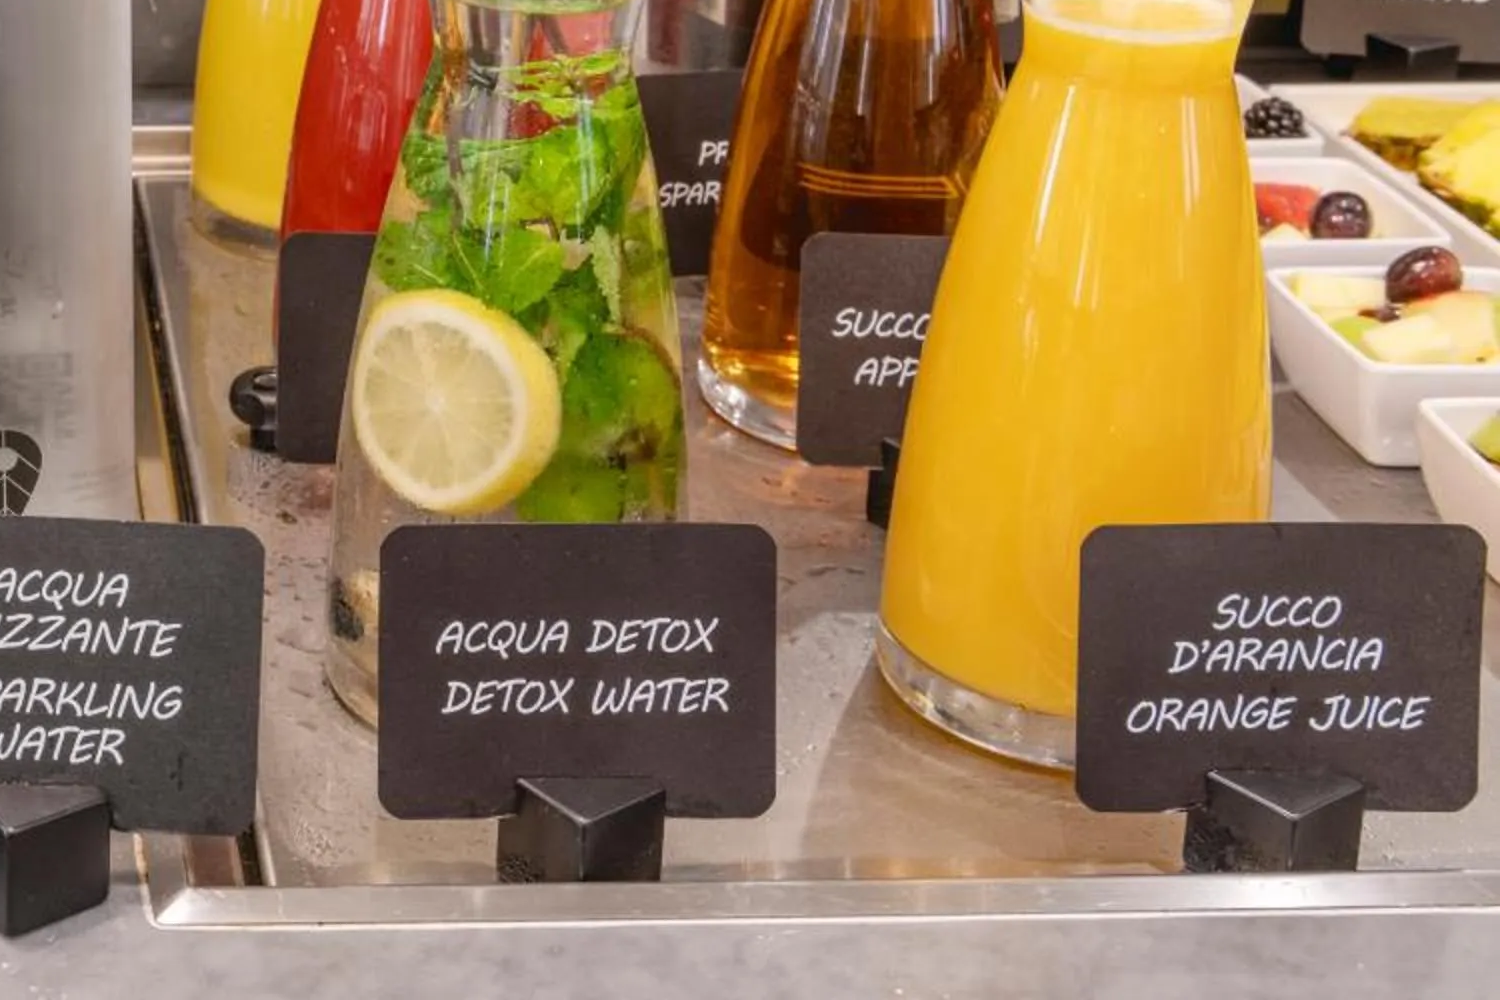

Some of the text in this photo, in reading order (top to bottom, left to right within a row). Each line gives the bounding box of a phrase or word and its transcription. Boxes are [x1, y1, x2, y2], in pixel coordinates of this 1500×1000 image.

[659, 180, 721, 208] SPAR
[854, 356, 919, 388] APP
[1212, 593, 1343, 631] SUCCO
[435, 617, 719, 660] ACQUA DETOX
[441, 676, 730, 716] DETOX WATER
[1126, 693, 1432, 734] ORANGE JUICE
